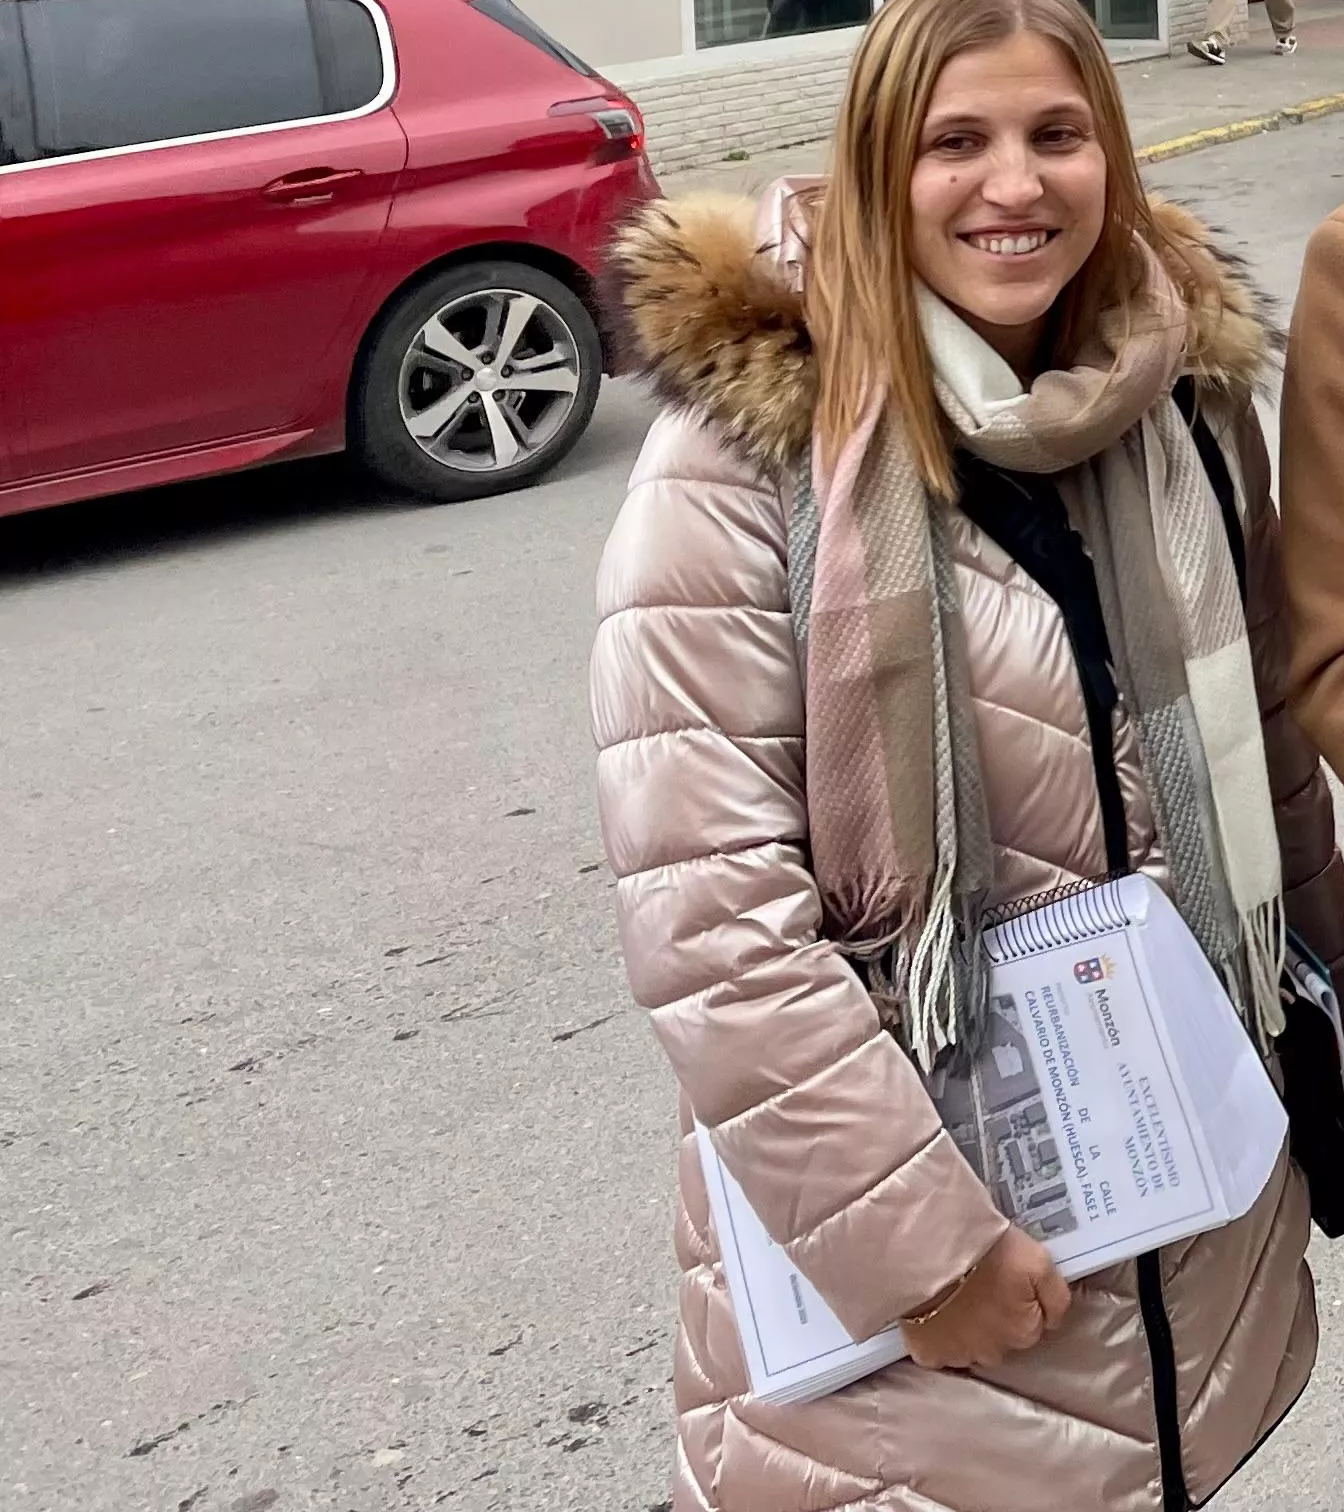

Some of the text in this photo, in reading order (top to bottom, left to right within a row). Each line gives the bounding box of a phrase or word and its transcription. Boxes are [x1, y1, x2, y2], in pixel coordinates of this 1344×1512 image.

[1024, 990, 1050, 1048] CALVARIO
[1095, 988, 1120, 1047] Monzón
[1043, 1049, 1055, 1065] DE
[1041, 986, 1079, 1087] REURBANIZACIÓN
[1078, 1107, 1091, 1123] DE
[1089, 1144, 1100, 1160] LA
[1099, 1180, 1117, 1216] CALLE
[1048, 1066, 1071, 1122] MONZÓN
[1117, 1061, 1164, 1194] AYUNTAMIENTO DE
[1138, 1076, 1181, 1187] EXCELENTÍSIMO
[1125, 1136, 1148, 1198] MONZÓN
[1081, 1183, 1098, 1213] FASE
[1089, 1213, 1100, 1222] 1
